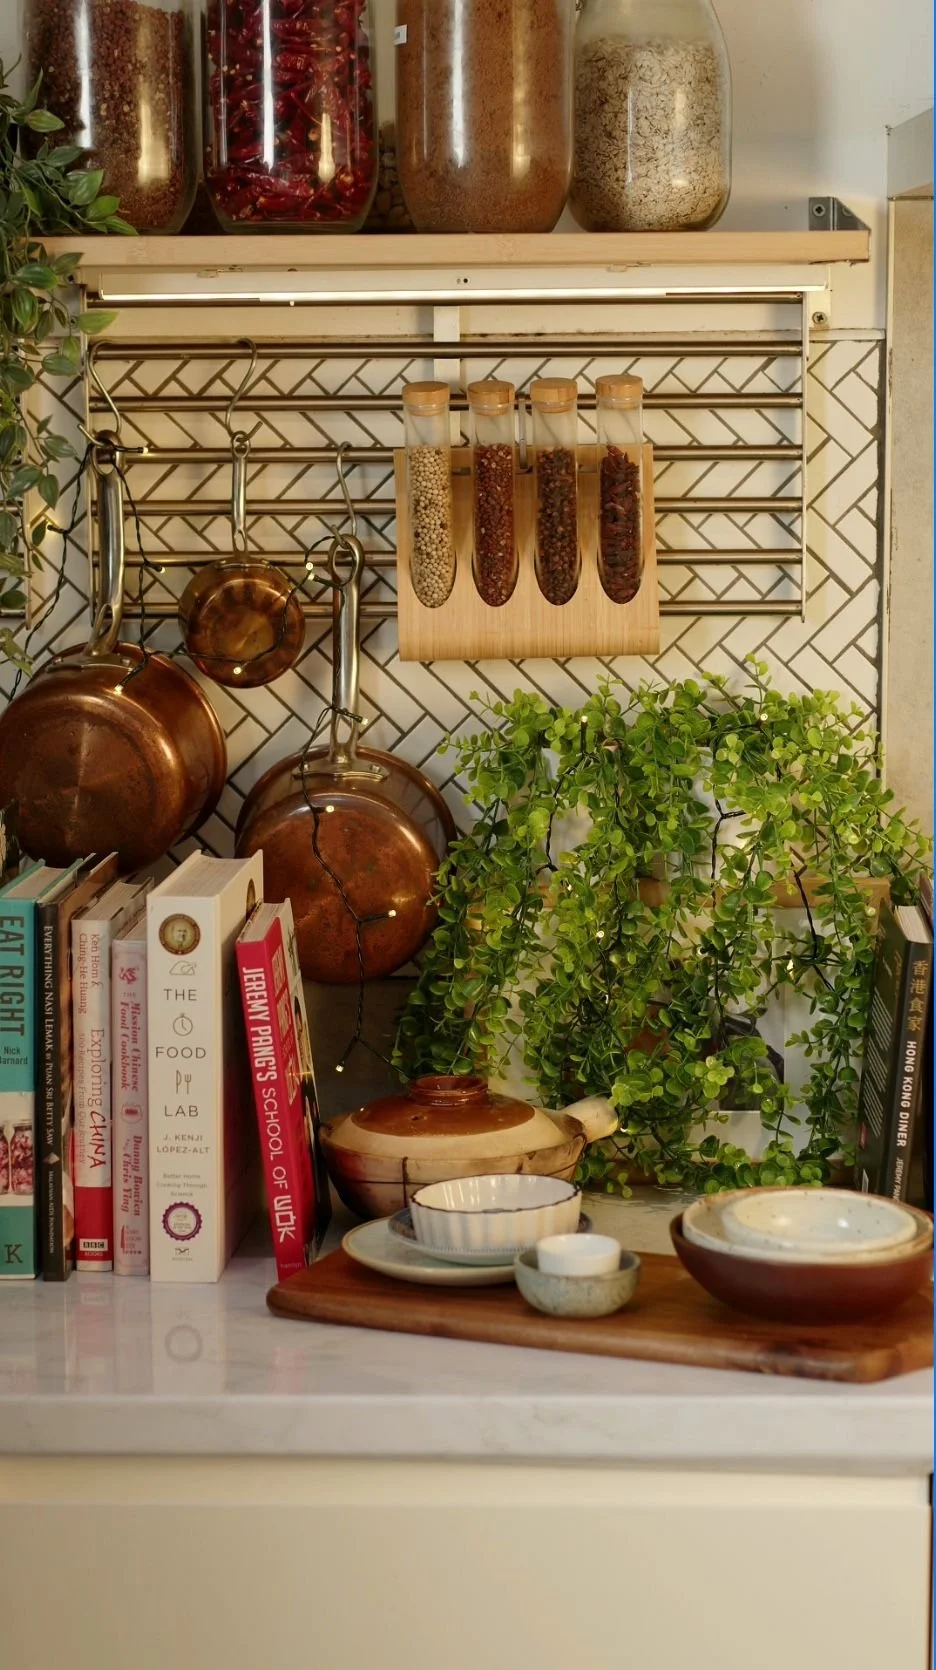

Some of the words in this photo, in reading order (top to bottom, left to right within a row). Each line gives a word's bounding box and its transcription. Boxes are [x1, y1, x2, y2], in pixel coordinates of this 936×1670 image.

[0, 916, 24, 956] EAT
[91, 934, 100, 952] Ken
[43, 926, 54, 988] EVERYTHING
[78, 933, 88, 979] Ching-He
[91, 956, 100, 978] Hom
[0, 965, 24, 1036] RIGHT
[44, 992, 54, 1015] NASI
[78, 982, 88, 1014] Huang
[163, 988, 197, 1001] THE
[242, 967, 270, 1021] JEREMY
[907, 959, 929, 1031] 香港食家
[121, 1002, 130, 1030] Food
[131, 1002, 141, 1045] Mission
[4, 1046, 20, 1055] Nick
[45, 1020, 55, 1051] LEMAK
[0, 1055, 28, 1065] arnard
[87, 1028, 107, 1107] Exploring
[121, 1033, 130, 1090] Cookbook
[155, 1046, 207, 1059] FOOD
[250, 1026, 277, 1082] PANG'S
[904, 1040, 917, 1073] HONG
[46, 1063, 54, 1085] PUAN
[131, 1048, 141, 1092] Chinese
[46, 1087, 54, 1099] SRI
[901, 1078, 915, 1109] KONG
[46, 1102, 54, 1126] BETTY
[164, 1105, 199, 1118] LAB
[262, 1087, 284, 1162] SCHOOL
[46, 1128, 54, 1145] SAW
[87, 1110, 107, 1168] CHINA
[174, 1134, 203, 1142] KENJI
[896, 1111, 910, 1147] DINER
[123, 1153, 132, 1183] Chris
[131, 1135, 143, 1172] Danny
[272, 1166, 288, 1190] OF
[894, 1156, 904, 1184] JEREMY
[121, 1187, 132, 1213] Ying
[132, 1176, 143, 1216] Bowien
[273, 1195, 297, 1243] WOK
[4, 1244, 23, 1264] K
